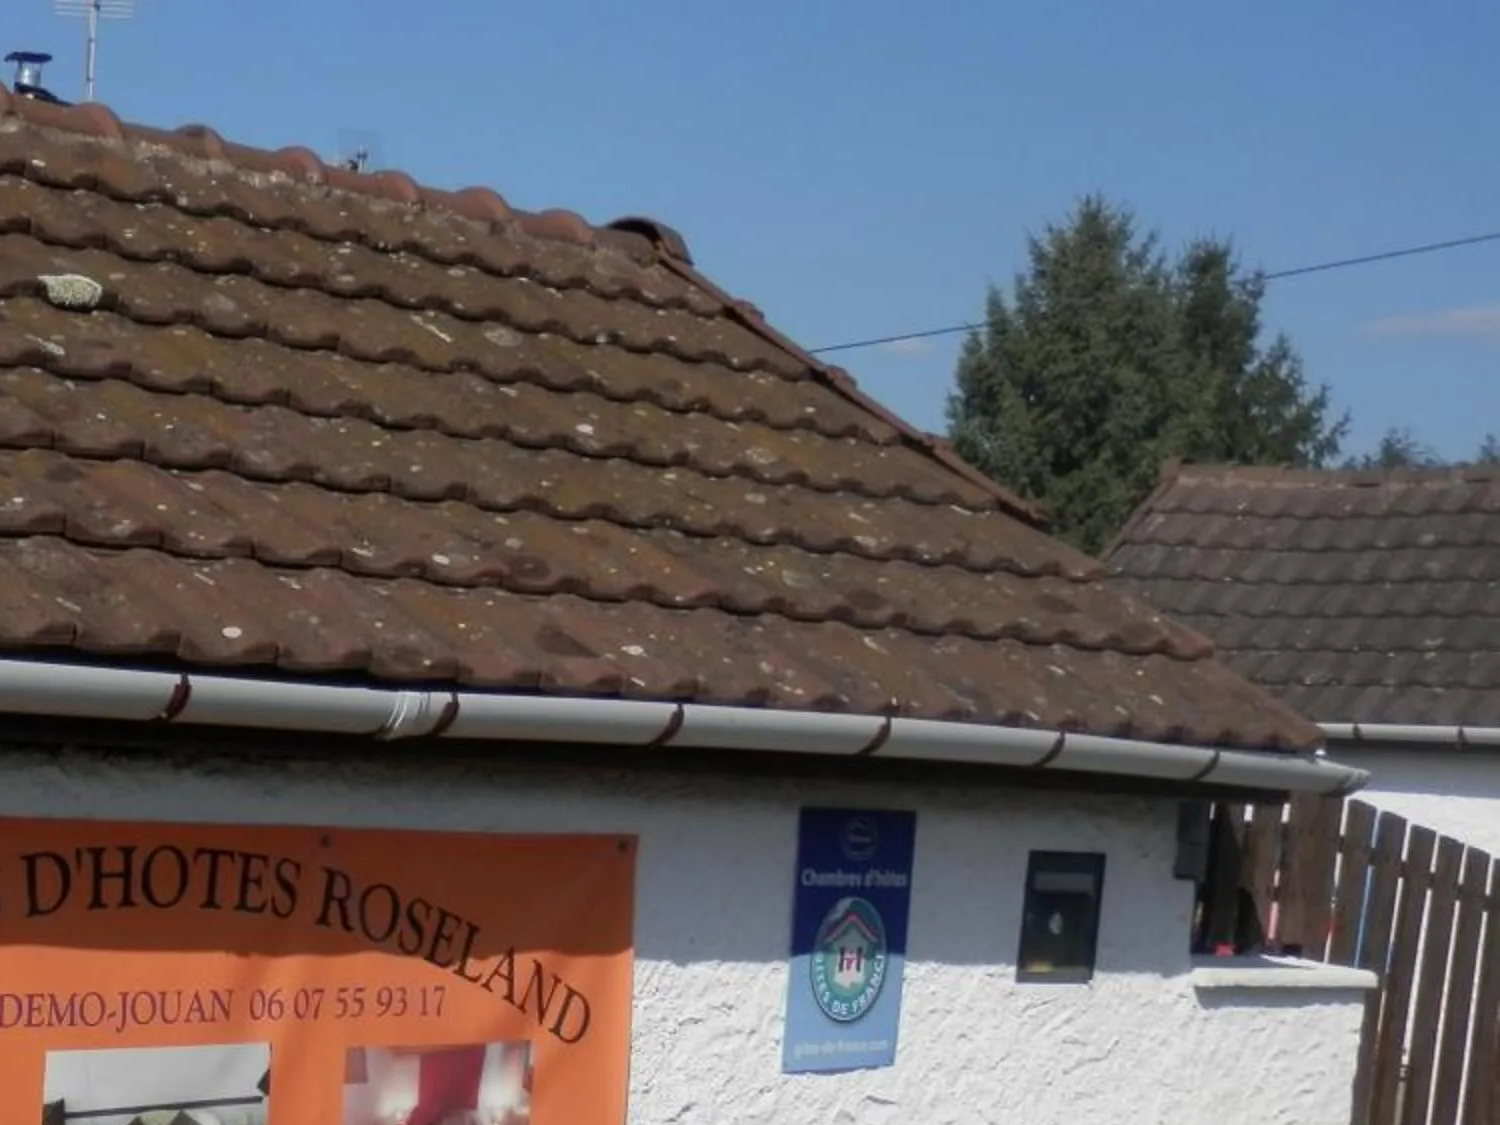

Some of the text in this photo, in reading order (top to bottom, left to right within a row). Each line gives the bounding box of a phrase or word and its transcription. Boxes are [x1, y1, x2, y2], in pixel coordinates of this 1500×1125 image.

[802, 868, 861, 887] Chambres
[20, 844, 301, 918] D'HOTES
[315, 867, 592, 1046] ROSELAND
[249, 988, 283, 1021] 06
[291, 987, 323, 1020] 07
[335, 986, 365, 1018] 55
[376, 985, 408, 1018] 93
[418, 985, 446, 1017] 17
[832, 1000, 849, 1014] DE
